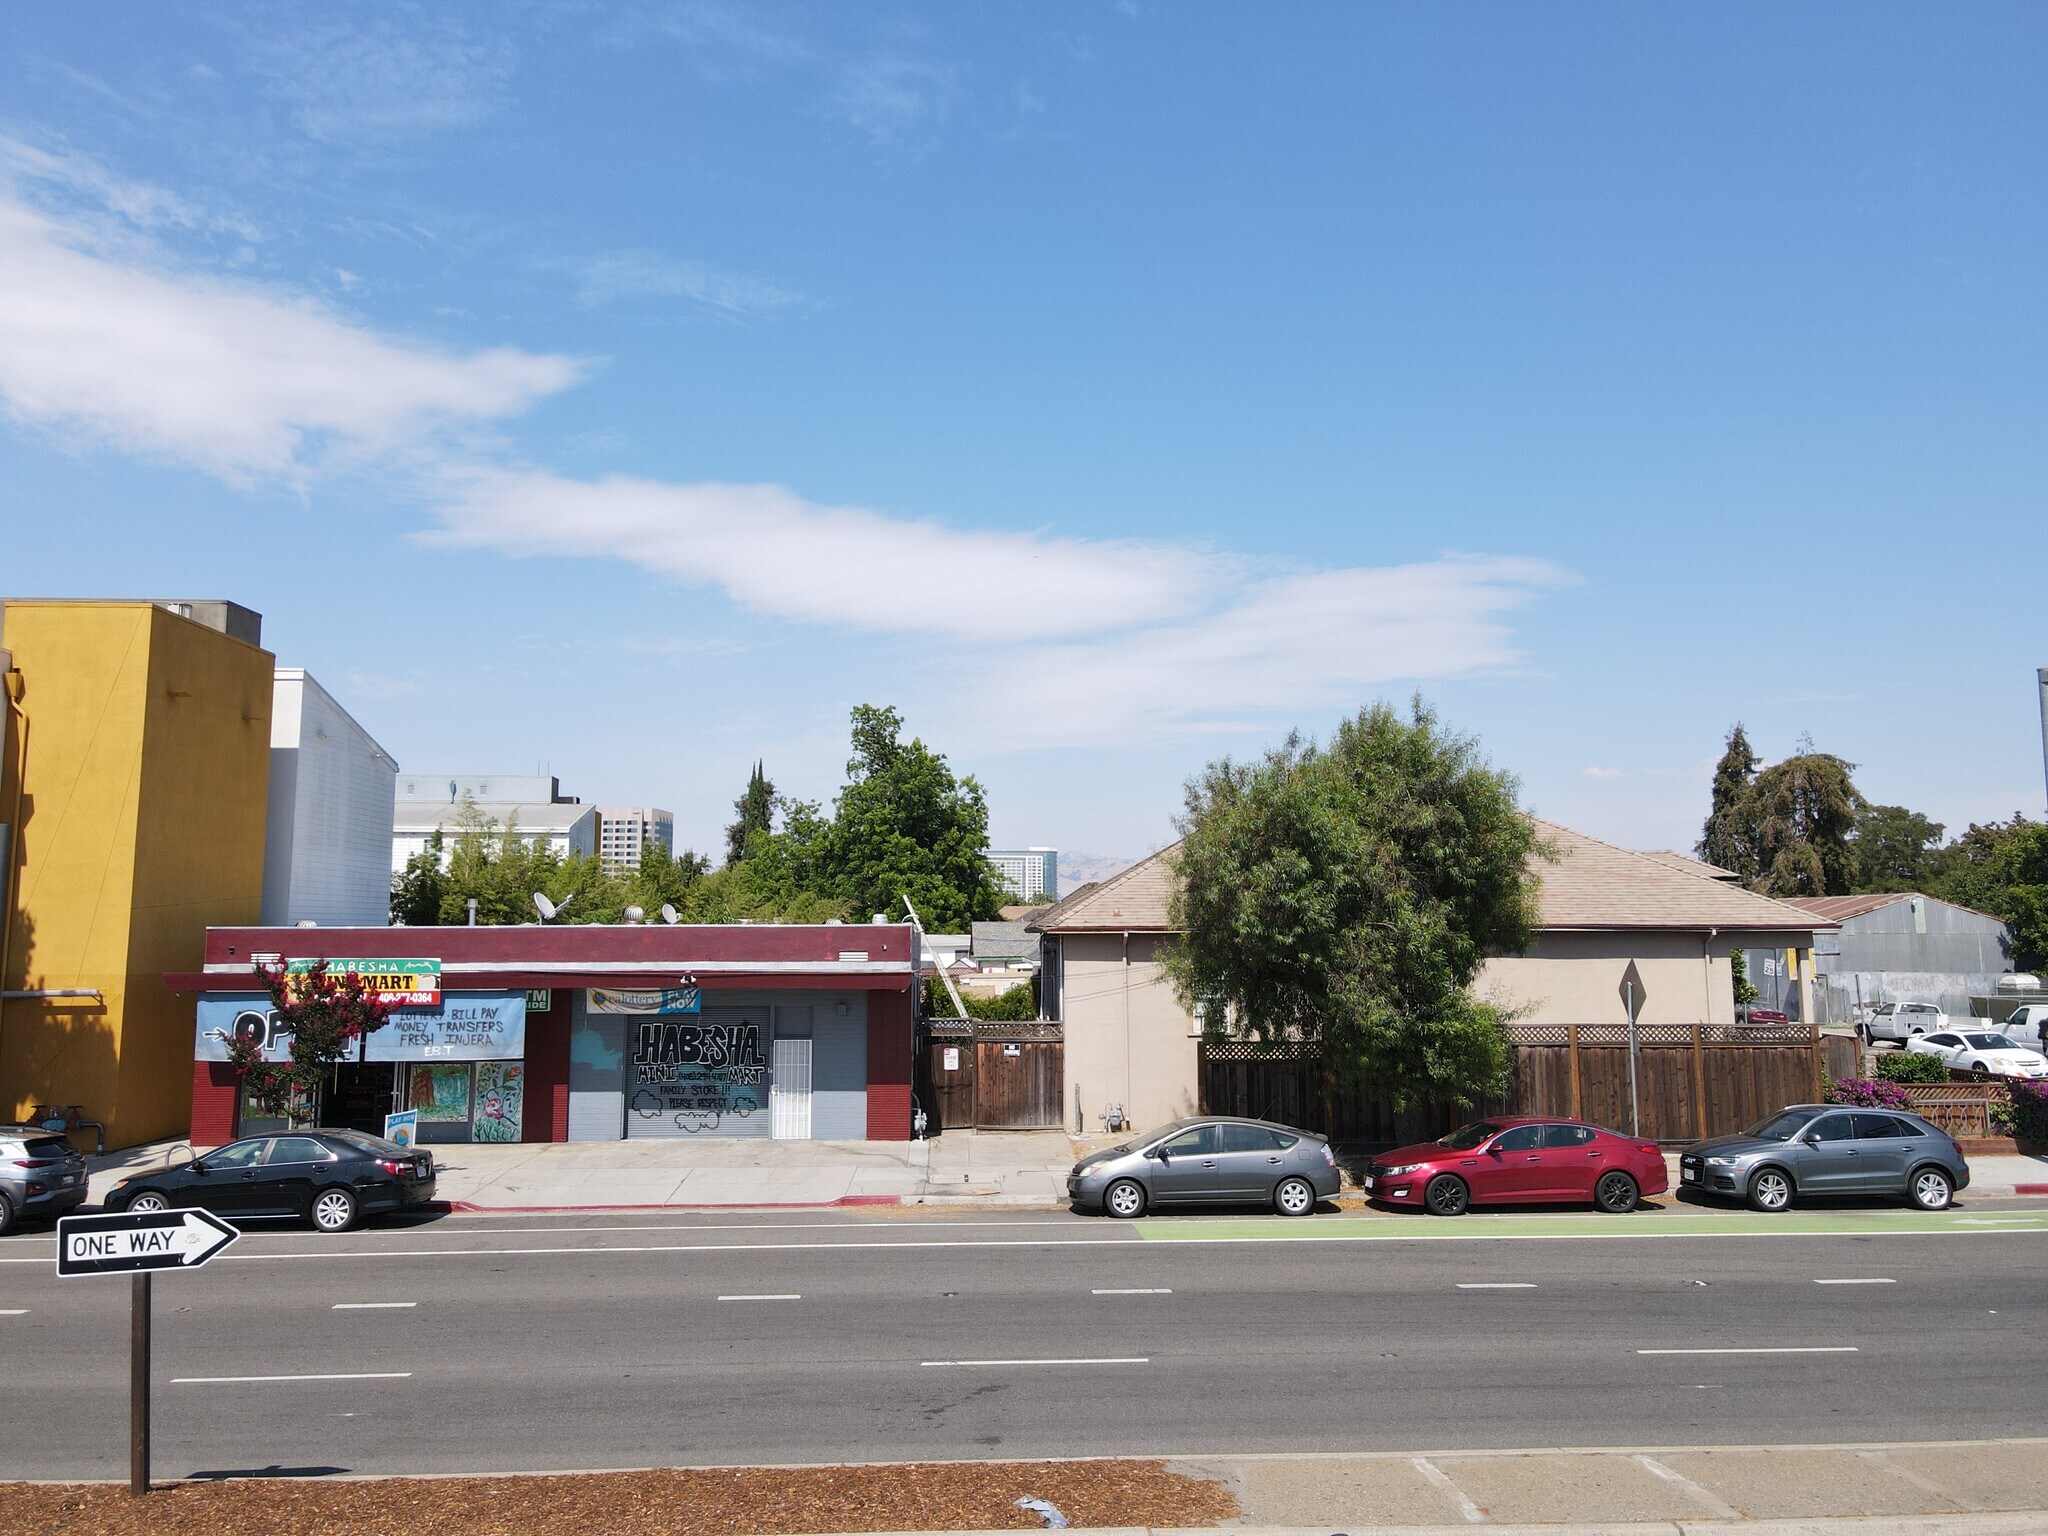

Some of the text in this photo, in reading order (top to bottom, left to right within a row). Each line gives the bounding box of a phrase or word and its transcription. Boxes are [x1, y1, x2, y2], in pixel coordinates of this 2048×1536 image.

[327, 961, 399, 972] HABESHA
[363, 975, 413, 990] MART
[526, 989, 546, 1002] TM
[667, 989, 697, 999] PLAY
[667, 998, 696, 1009] NOW
[400, 1007, 499, 1021] LOTTERY BILL PAY
[394, 1020, 504, 1034] MONEY TRANSFERS
[400, 1033, 494, 1047] FRESH INJERA
[634, 1023, 765, 1068] HABESHA
[637, 1064, 678, 1085] MINI
[726, 1065, 765, 1086] MART
[660, 1085, 687, 1096] FAMILY
[669, 1097, 694, 1109] PLEASE
[388, 1114, 415, 1124] PLAY NOW
[73, 1235, 117, 1257] ONE
[129, 1230, 176, 1252] WAY
